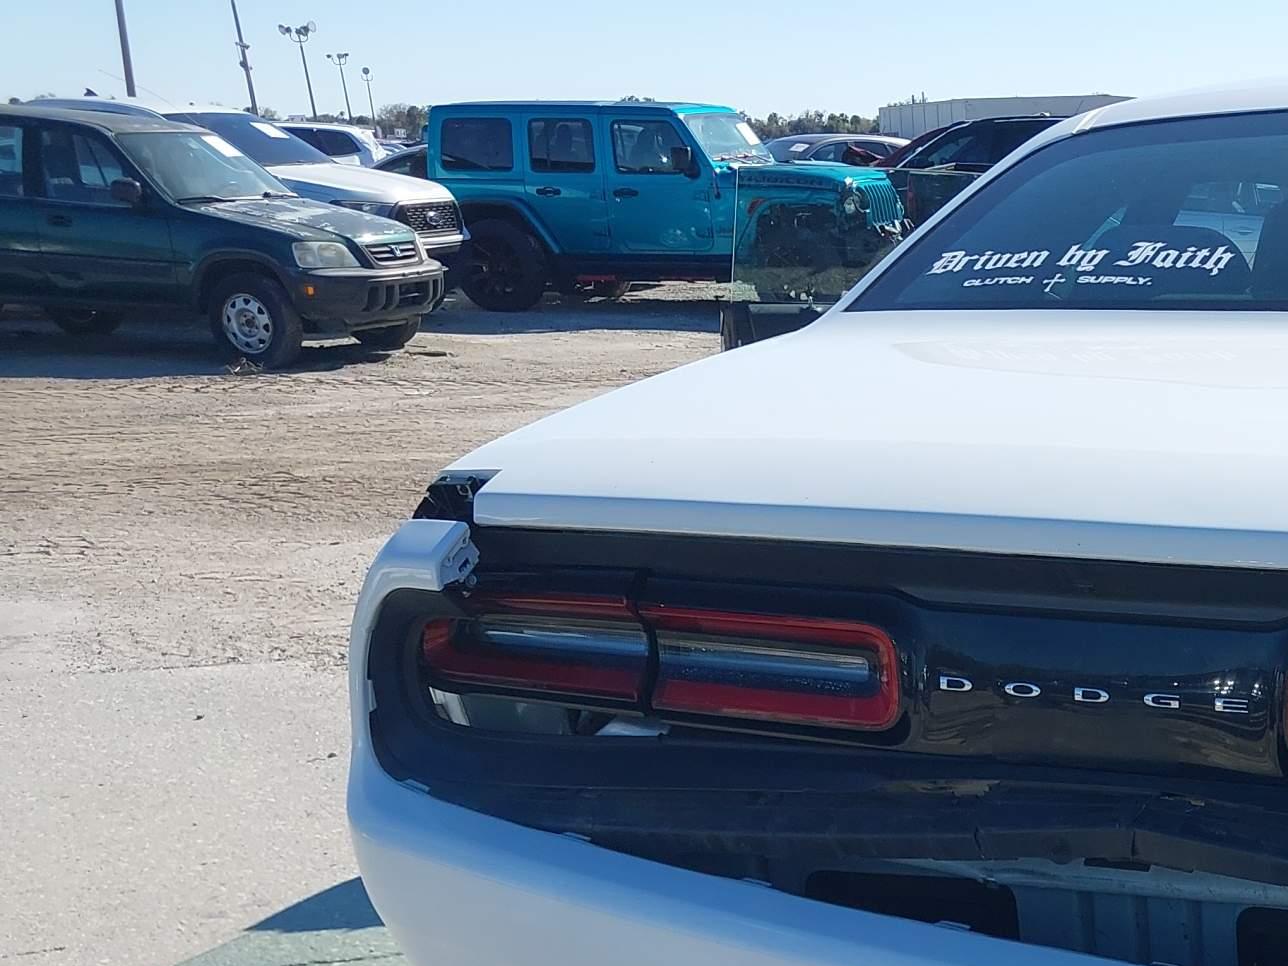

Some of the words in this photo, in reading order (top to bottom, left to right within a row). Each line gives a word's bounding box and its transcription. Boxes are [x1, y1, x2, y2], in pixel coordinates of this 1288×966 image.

[926, 250, 1049, 275] Driven
[1056, 245, 1110, 271] by
[1113, 241, 1236, 276] Faith
[962, 276, 1034, 287] CLUTCH
[939, 675, 1249, 714] DODGE
